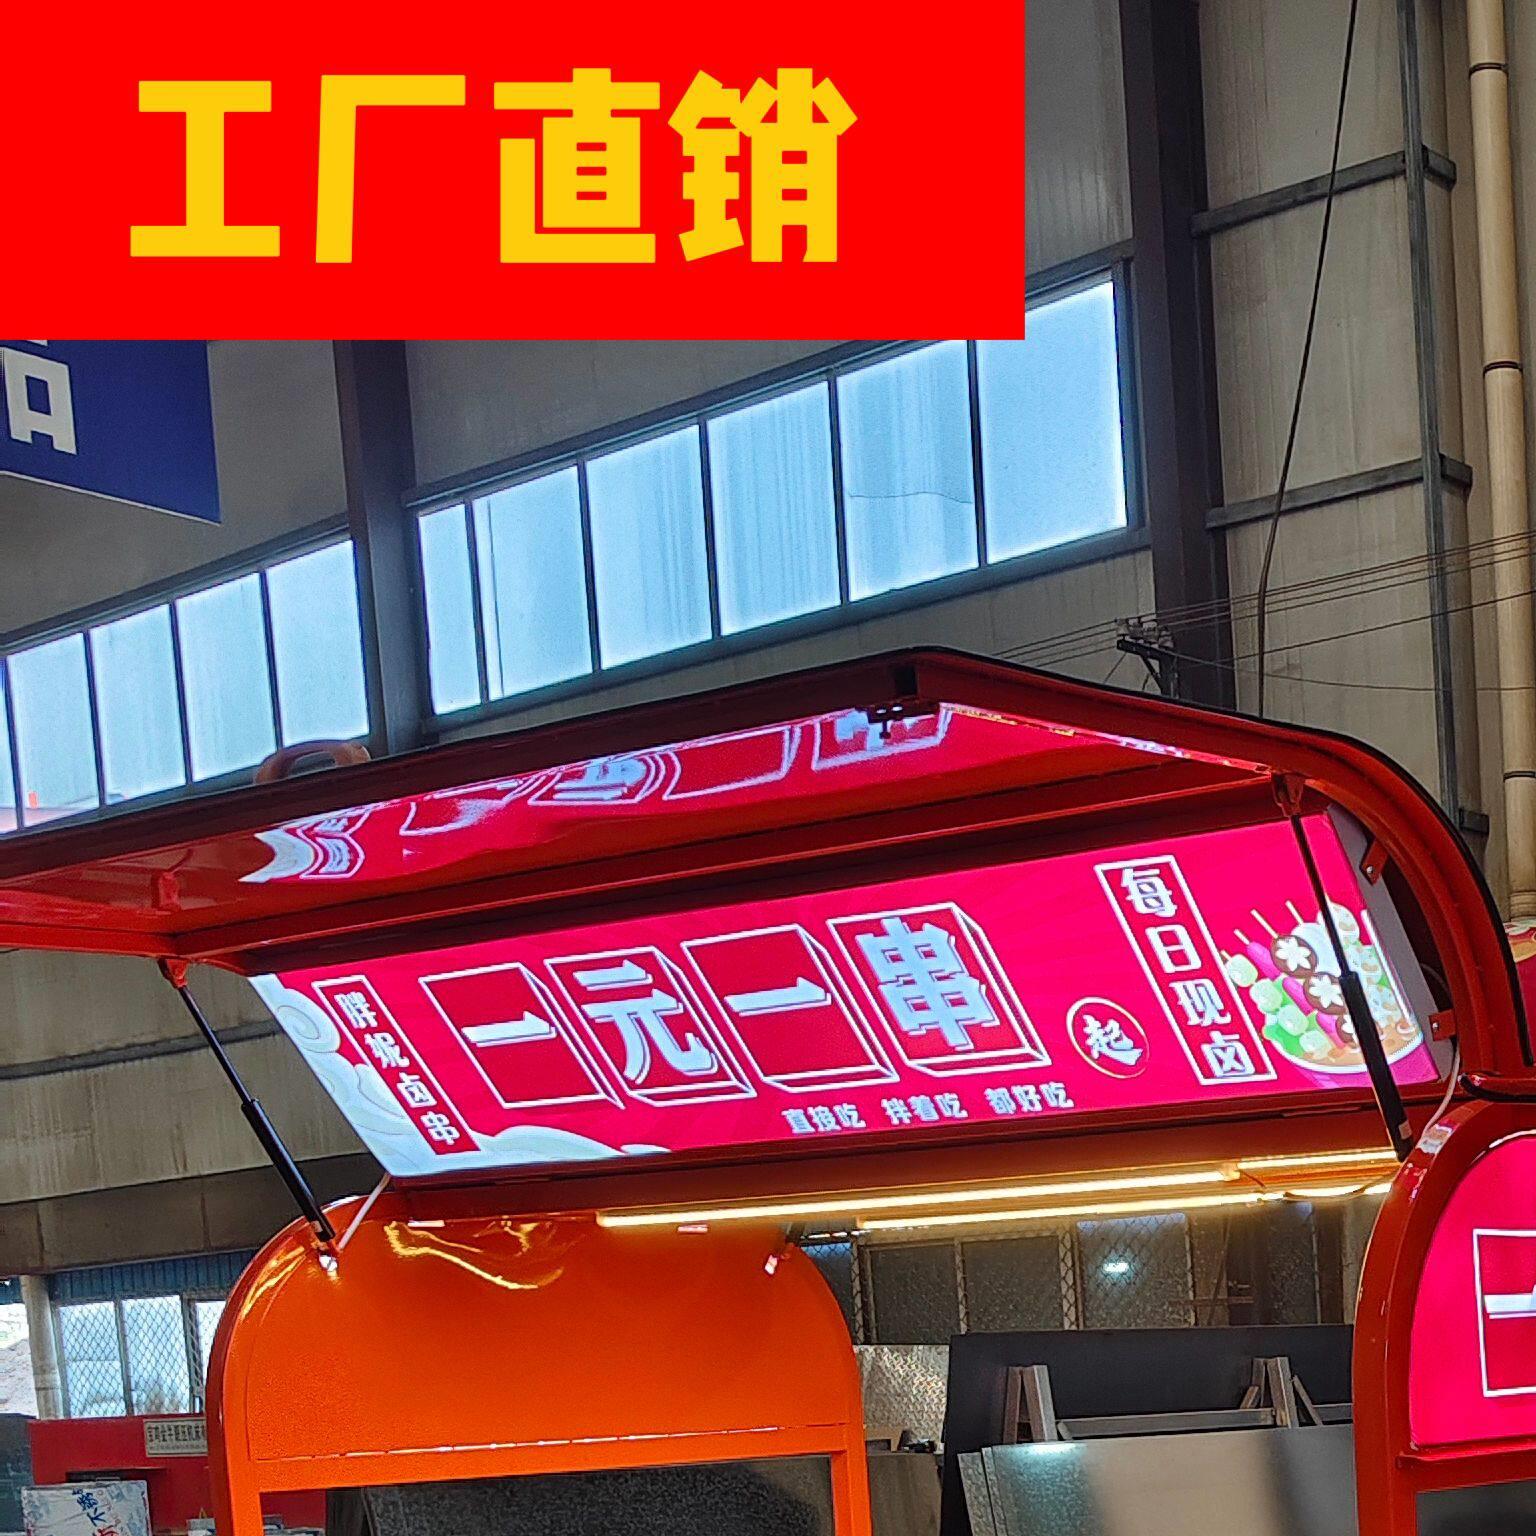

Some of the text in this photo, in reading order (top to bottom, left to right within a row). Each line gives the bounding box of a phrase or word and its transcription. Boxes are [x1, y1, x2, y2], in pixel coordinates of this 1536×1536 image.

[460, 915, 1144, 1084] 一元一串 起
[1120, 867, 1256, 1078] 每日现卤
[333, 991, 461, 1145] 胖妮卤串
[781, 1082, 1075, 1134] 直接吃 拌着吃 都好吃
